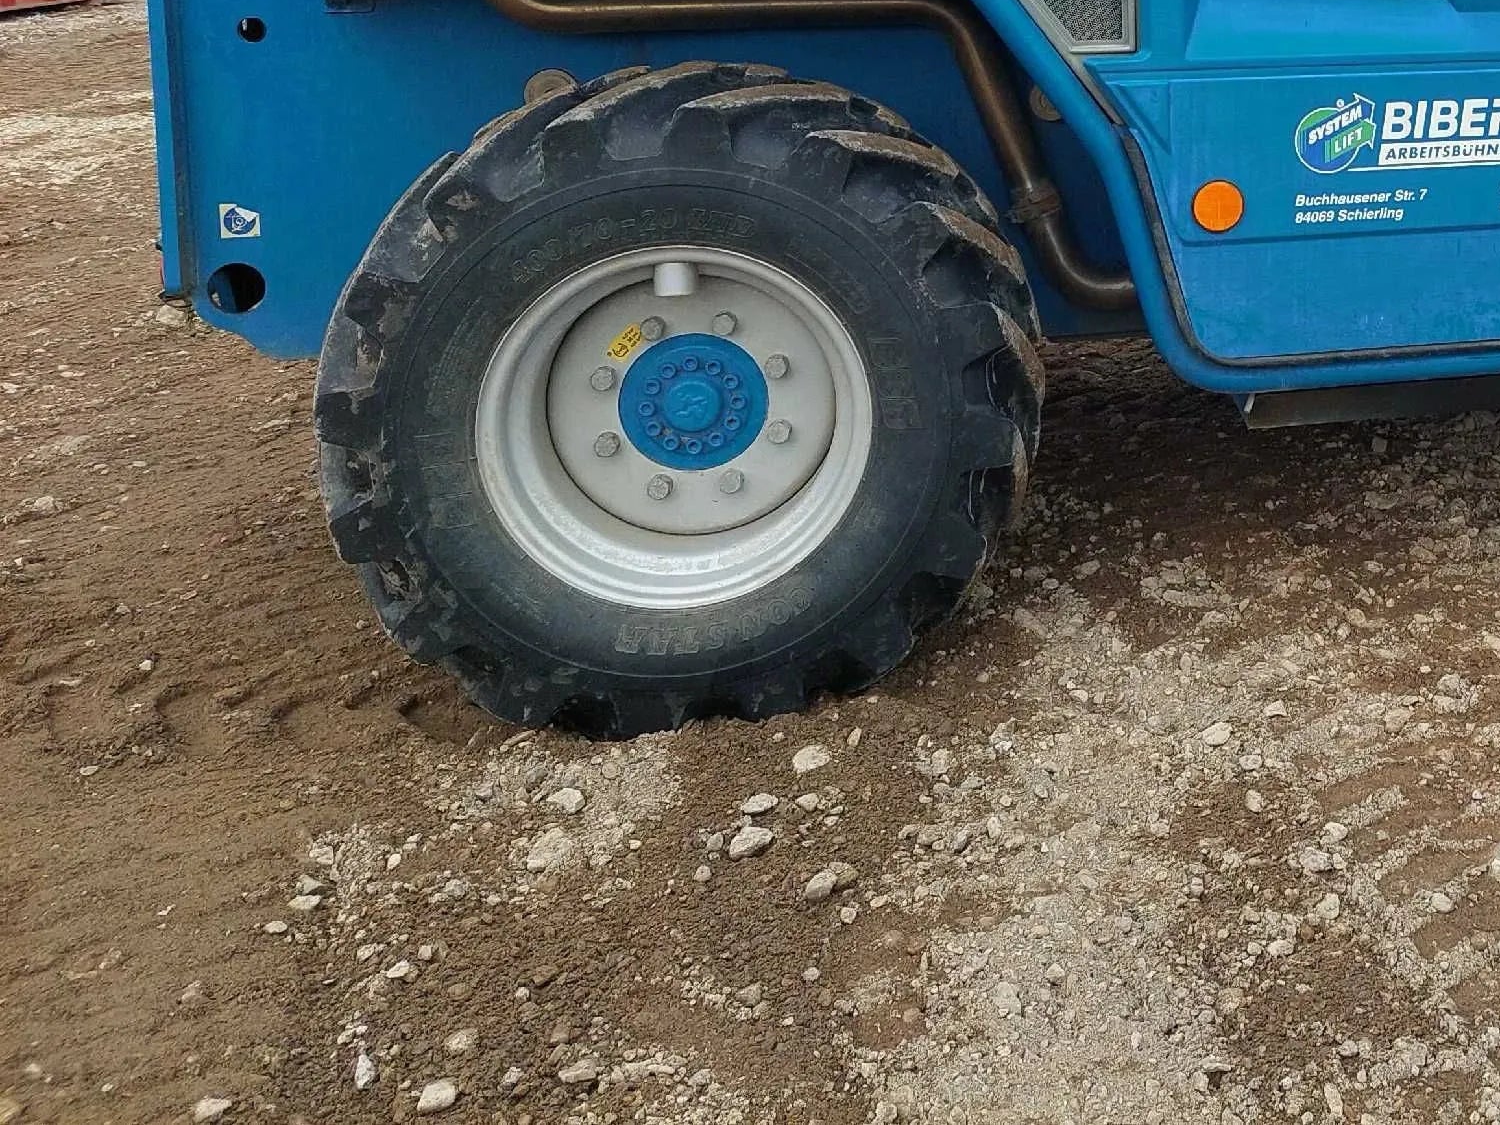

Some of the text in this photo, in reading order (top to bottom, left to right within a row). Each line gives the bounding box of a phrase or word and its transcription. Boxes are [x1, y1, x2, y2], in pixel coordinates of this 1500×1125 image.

[1308, 104, 1363, 145] SYSTEM
[1334, 127, 1363, 153] LIFT
[1295, 188, 1428, 207] Buchhausener Str. 7
[1295, 207, 1404, 224] 84069 Schierling
